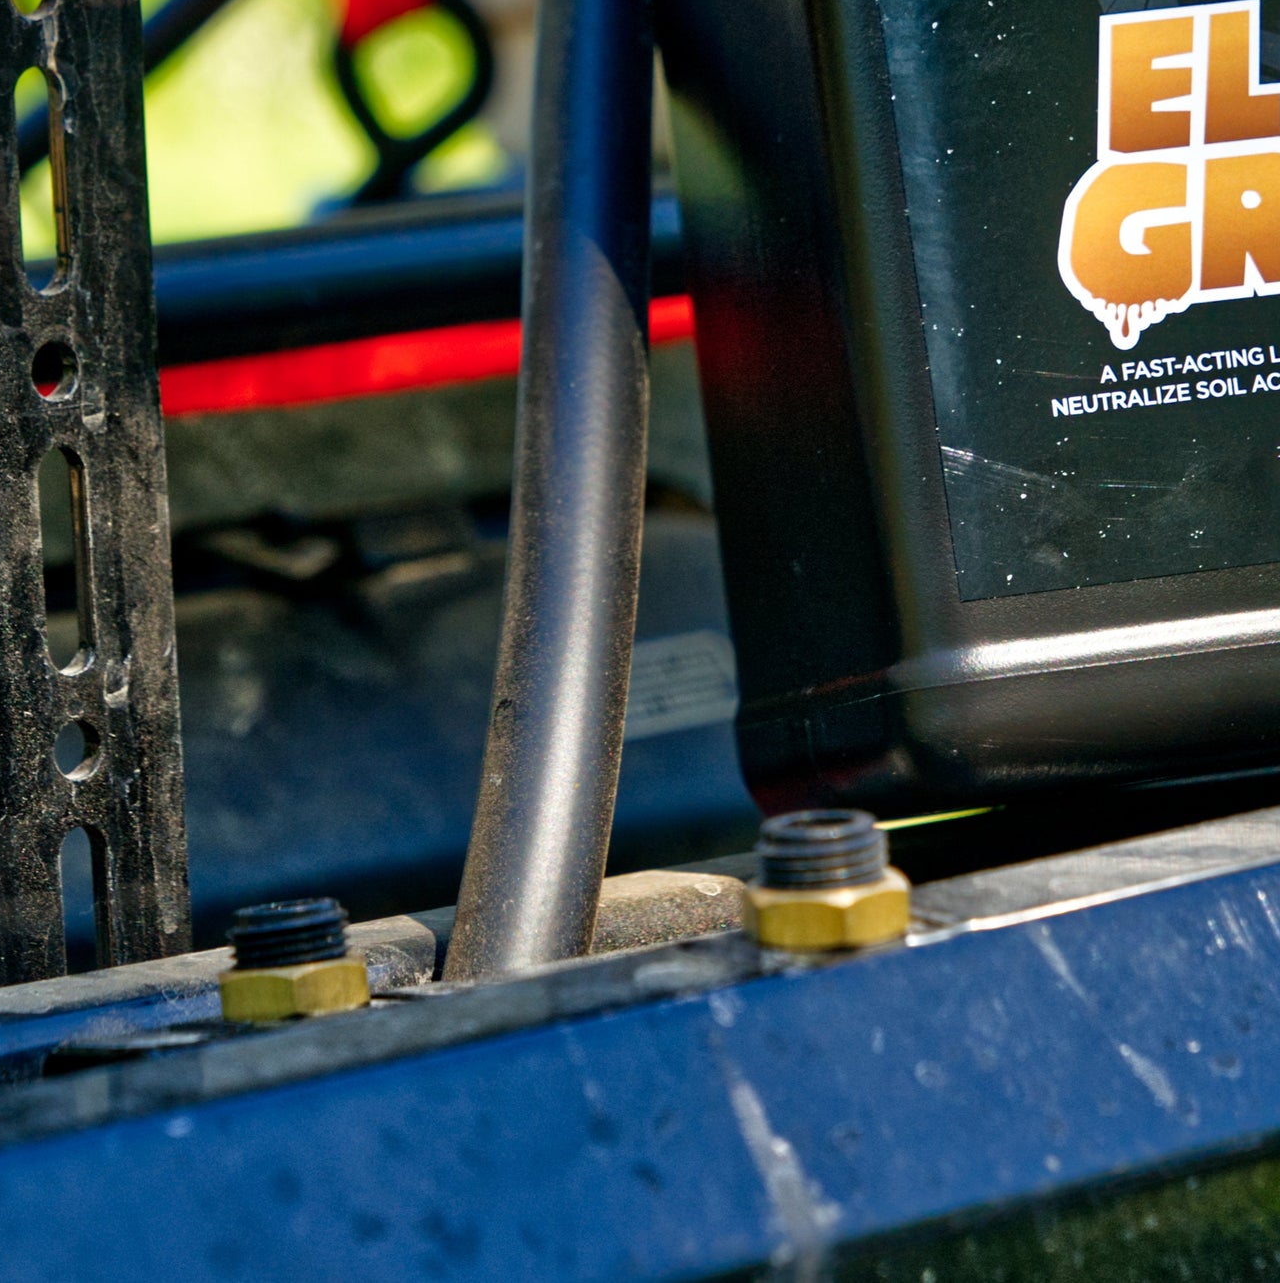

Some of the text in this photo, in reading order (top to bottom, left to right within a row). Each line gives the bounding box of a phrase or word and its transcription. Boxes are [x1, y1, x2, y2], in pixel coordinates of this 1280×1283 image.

[1100, 365, 1118, 384] A
[1122, 346, 1264, 381] FAST-ACTING
[1051, 382, 1191, 418] NEUTRALIZE
[1196, 378, 1247, 400] SOIL
